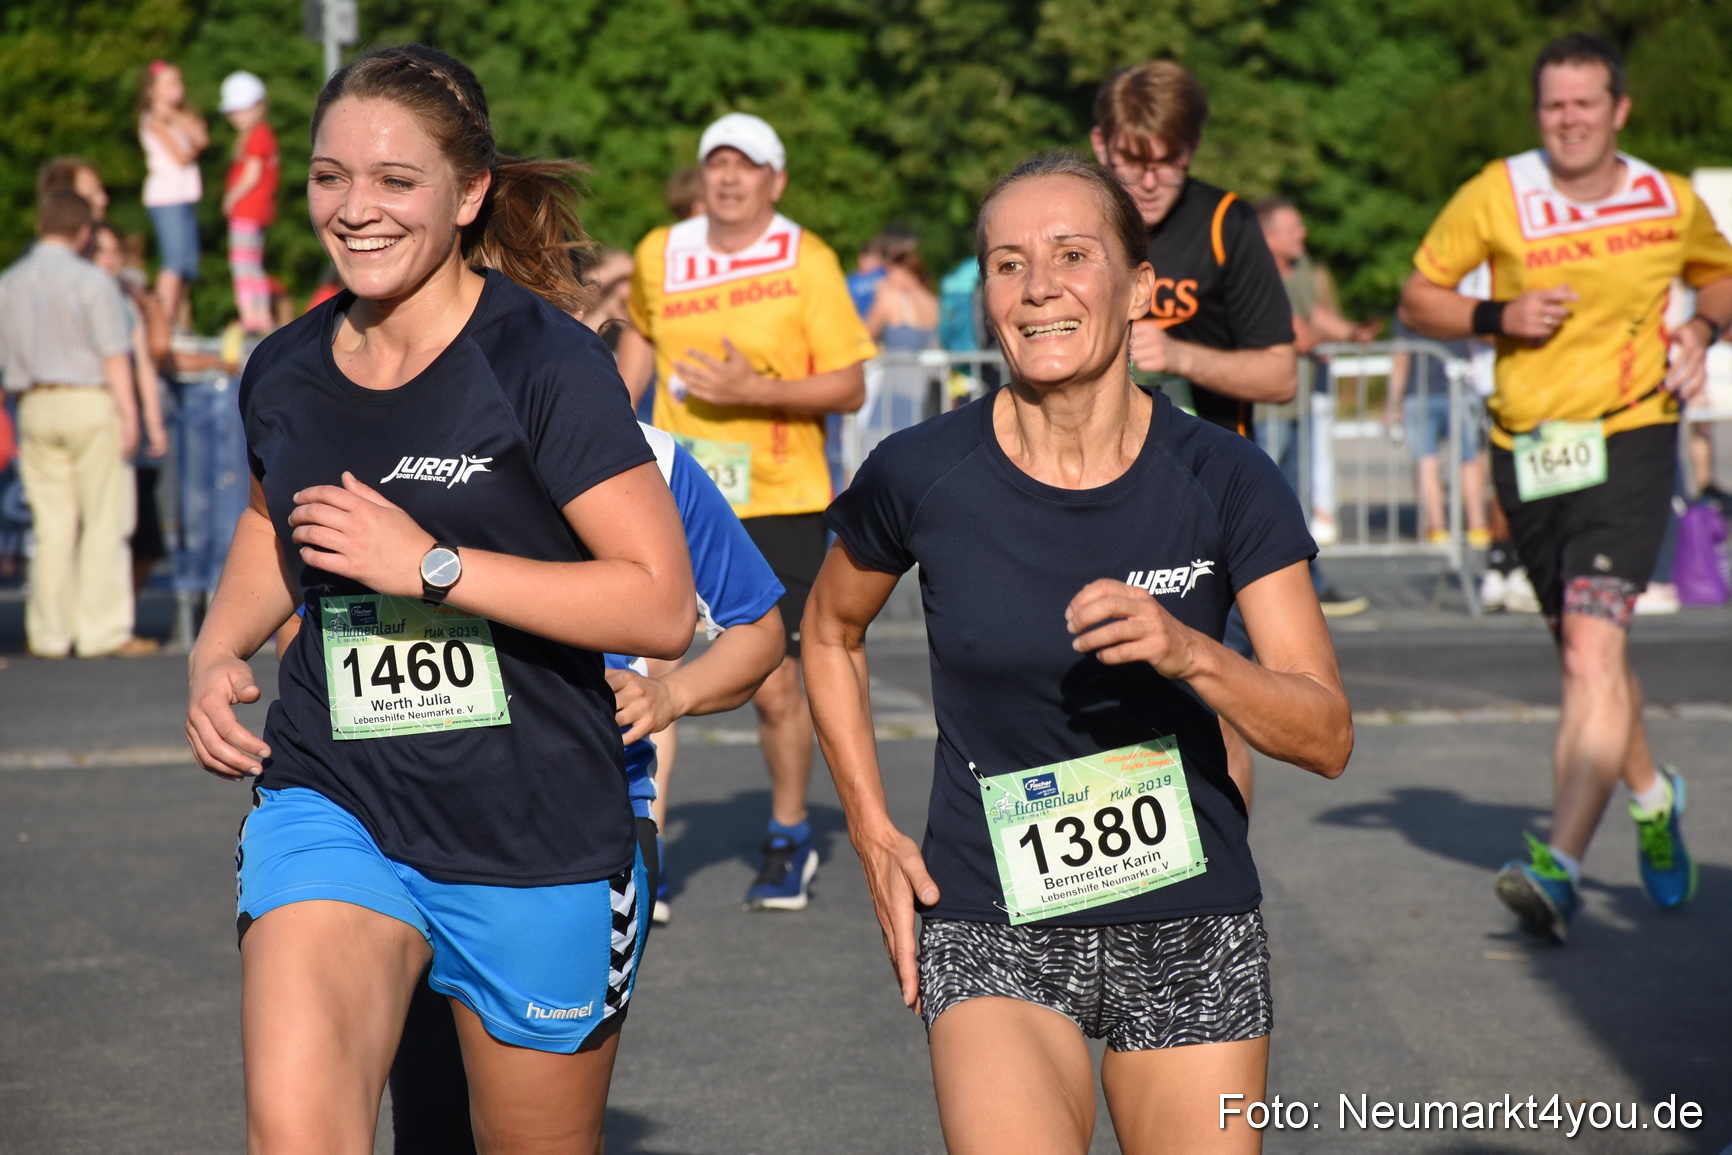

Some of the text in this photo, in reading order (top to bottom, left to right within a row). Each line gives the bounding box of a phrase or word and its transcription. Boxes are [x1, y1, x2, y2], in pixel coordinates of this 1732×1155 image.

[1526, 240, 1595, 271] MAX
[662, 279, 799, 320] MAX BÖGL
[380, 456, 460, 484] JURA
[1528, 442, 1591, 475] 1640
[420, 474, 447, 482] SERVICE
[1155, 586, 1180, 595] SERVICE
[343, 619, 406, 637] firmenlauf
[449, 626, 479, 638] 2019
[342, 639, 475, 698] 1460
[371, 693, 451, 712] Werth Julia
[353, 712, 405, 725] Lebenshilfe
[408, 707, 455, 720] Neumarkt
[467, 705, 474, 713] V
[1138, 775, 1171, 794] 2019
[1015, 786, 1090, 816] firmenlauf
[1017, 810, 1050, 821] neumarkt
[1019, 795, 1167, 875] 1380
[1044, 863, 1118, 890] Bernreiter
[1122, 850, 1162, 871] Karin
[1041, 883, 1099, 904] Lebenshilfe
[1101, 869, 1150, 889] Neumarkt
[1151, 867, 1161, 875] e.
[1161, 861, 1169, 870] V
[526, 1000, 594, 1020] hummel
